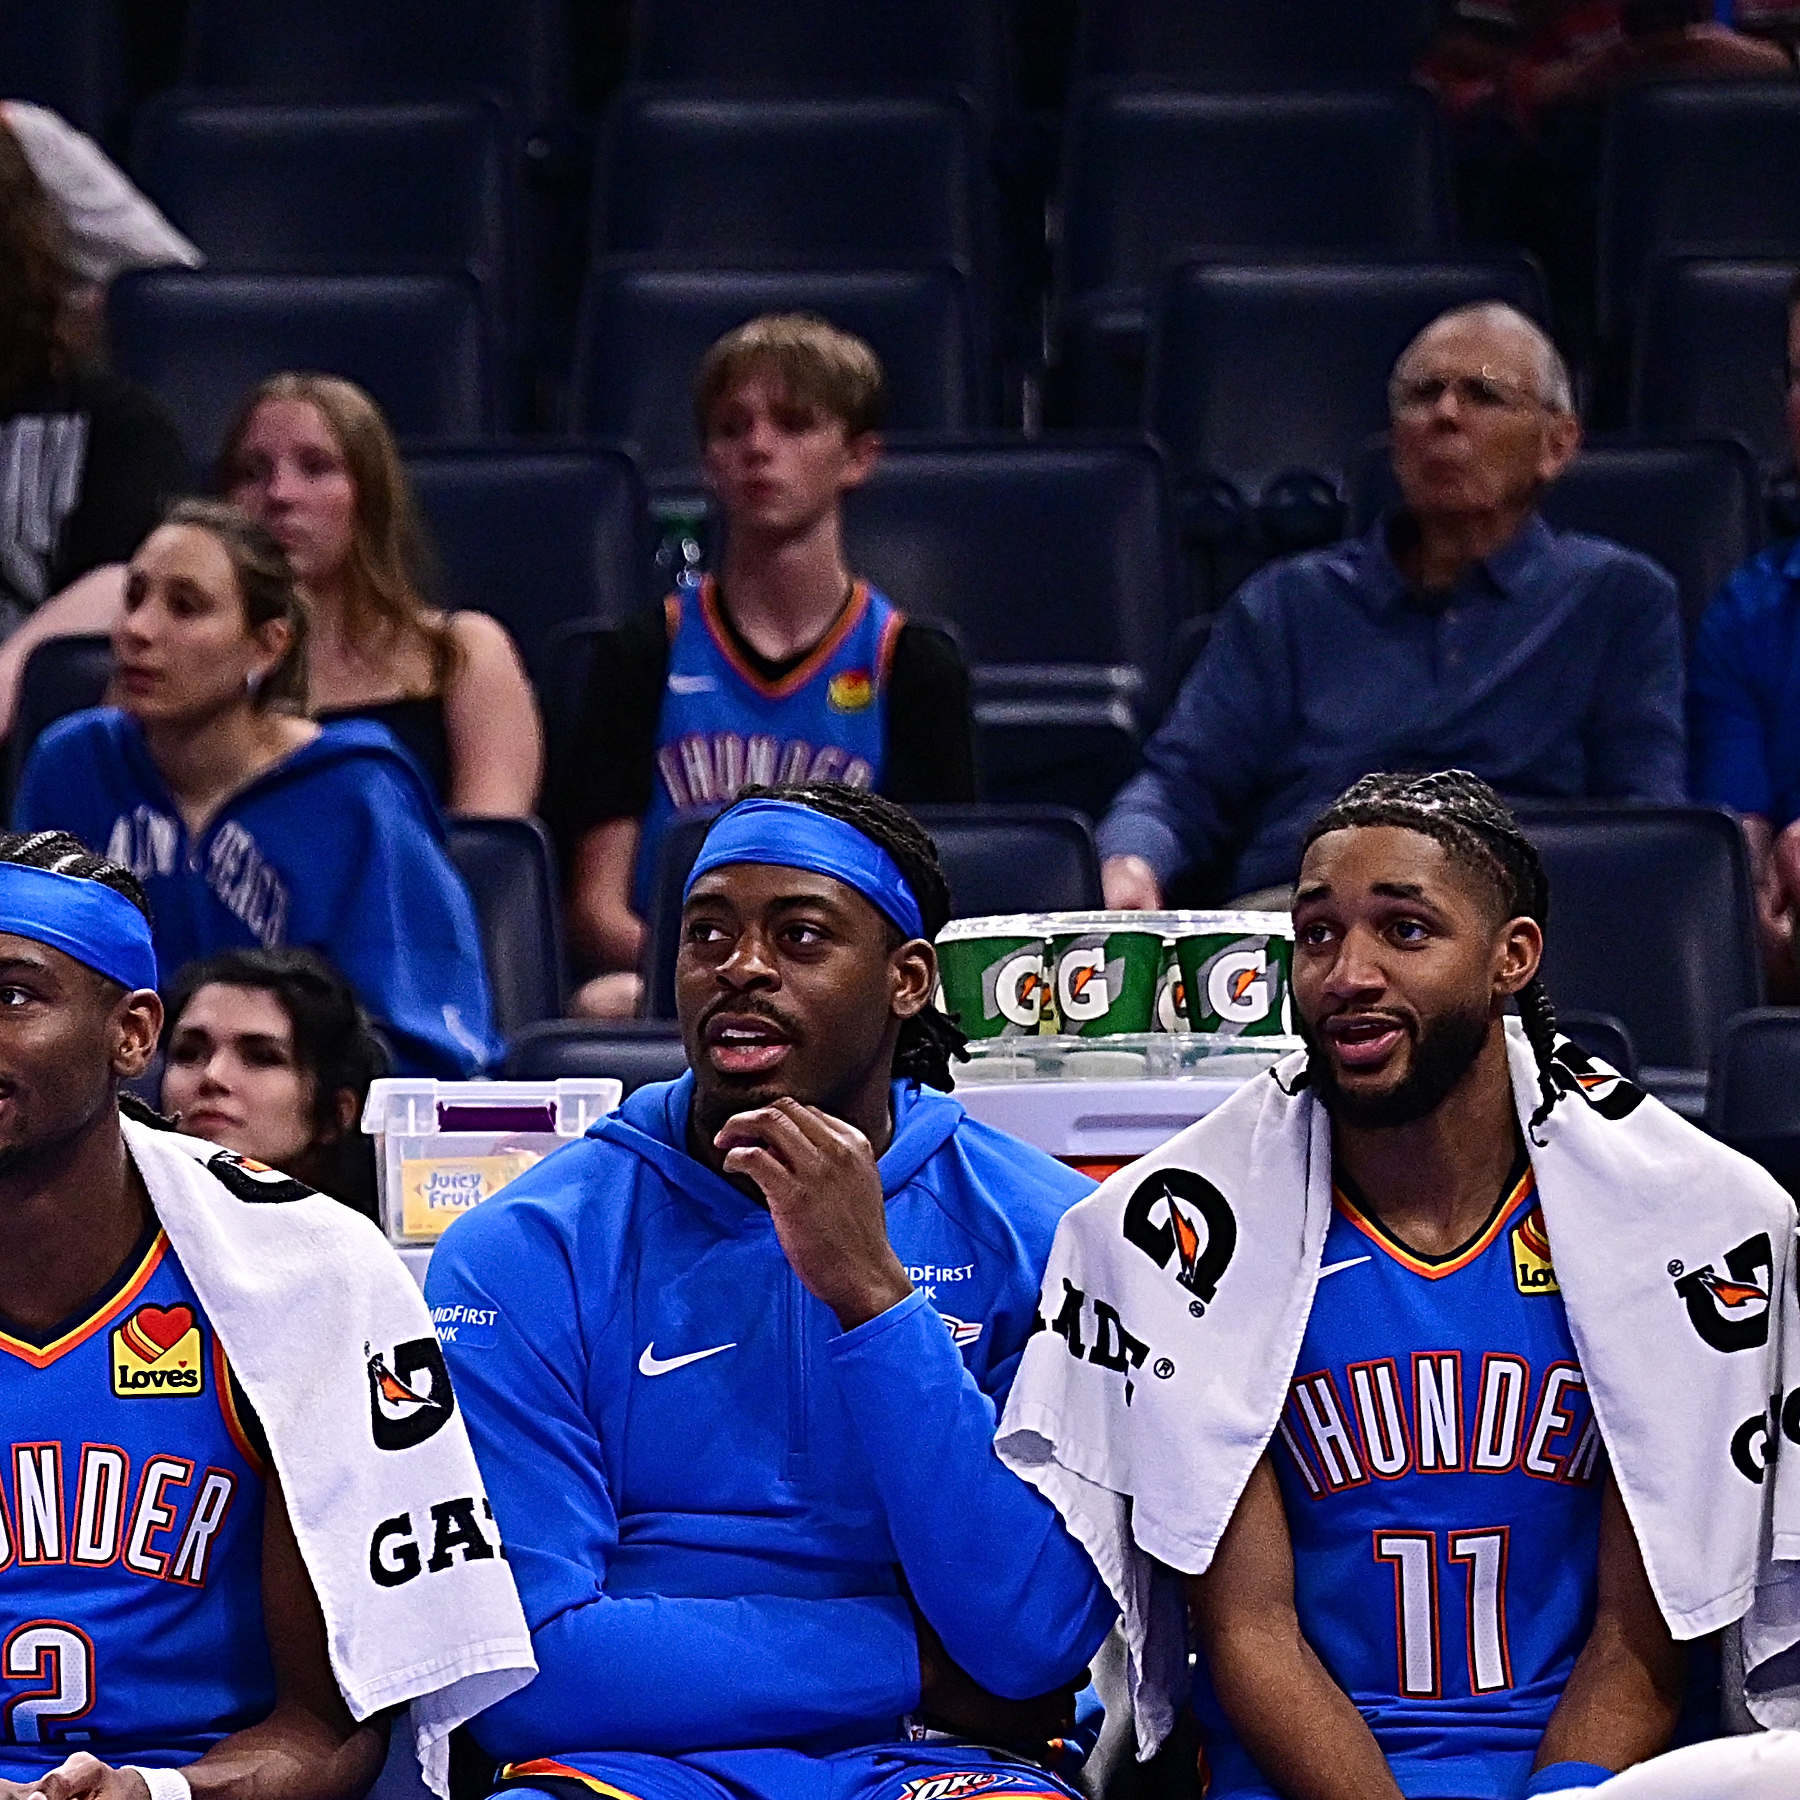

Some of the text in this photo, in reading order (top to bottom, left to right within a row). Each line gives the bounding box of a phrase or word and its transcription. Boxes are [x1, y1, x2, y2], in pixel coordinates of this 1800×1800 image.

[1058, 946, 1110, 1021] G
[1207, 949, 1268, 1024] G
[424, 1172, 482, 1191] Juicy
[370, 1497, 507, 1588] GA
[1372, 1526, 1515, 1700] 11
[2, 1618, 97, 1745] 2
